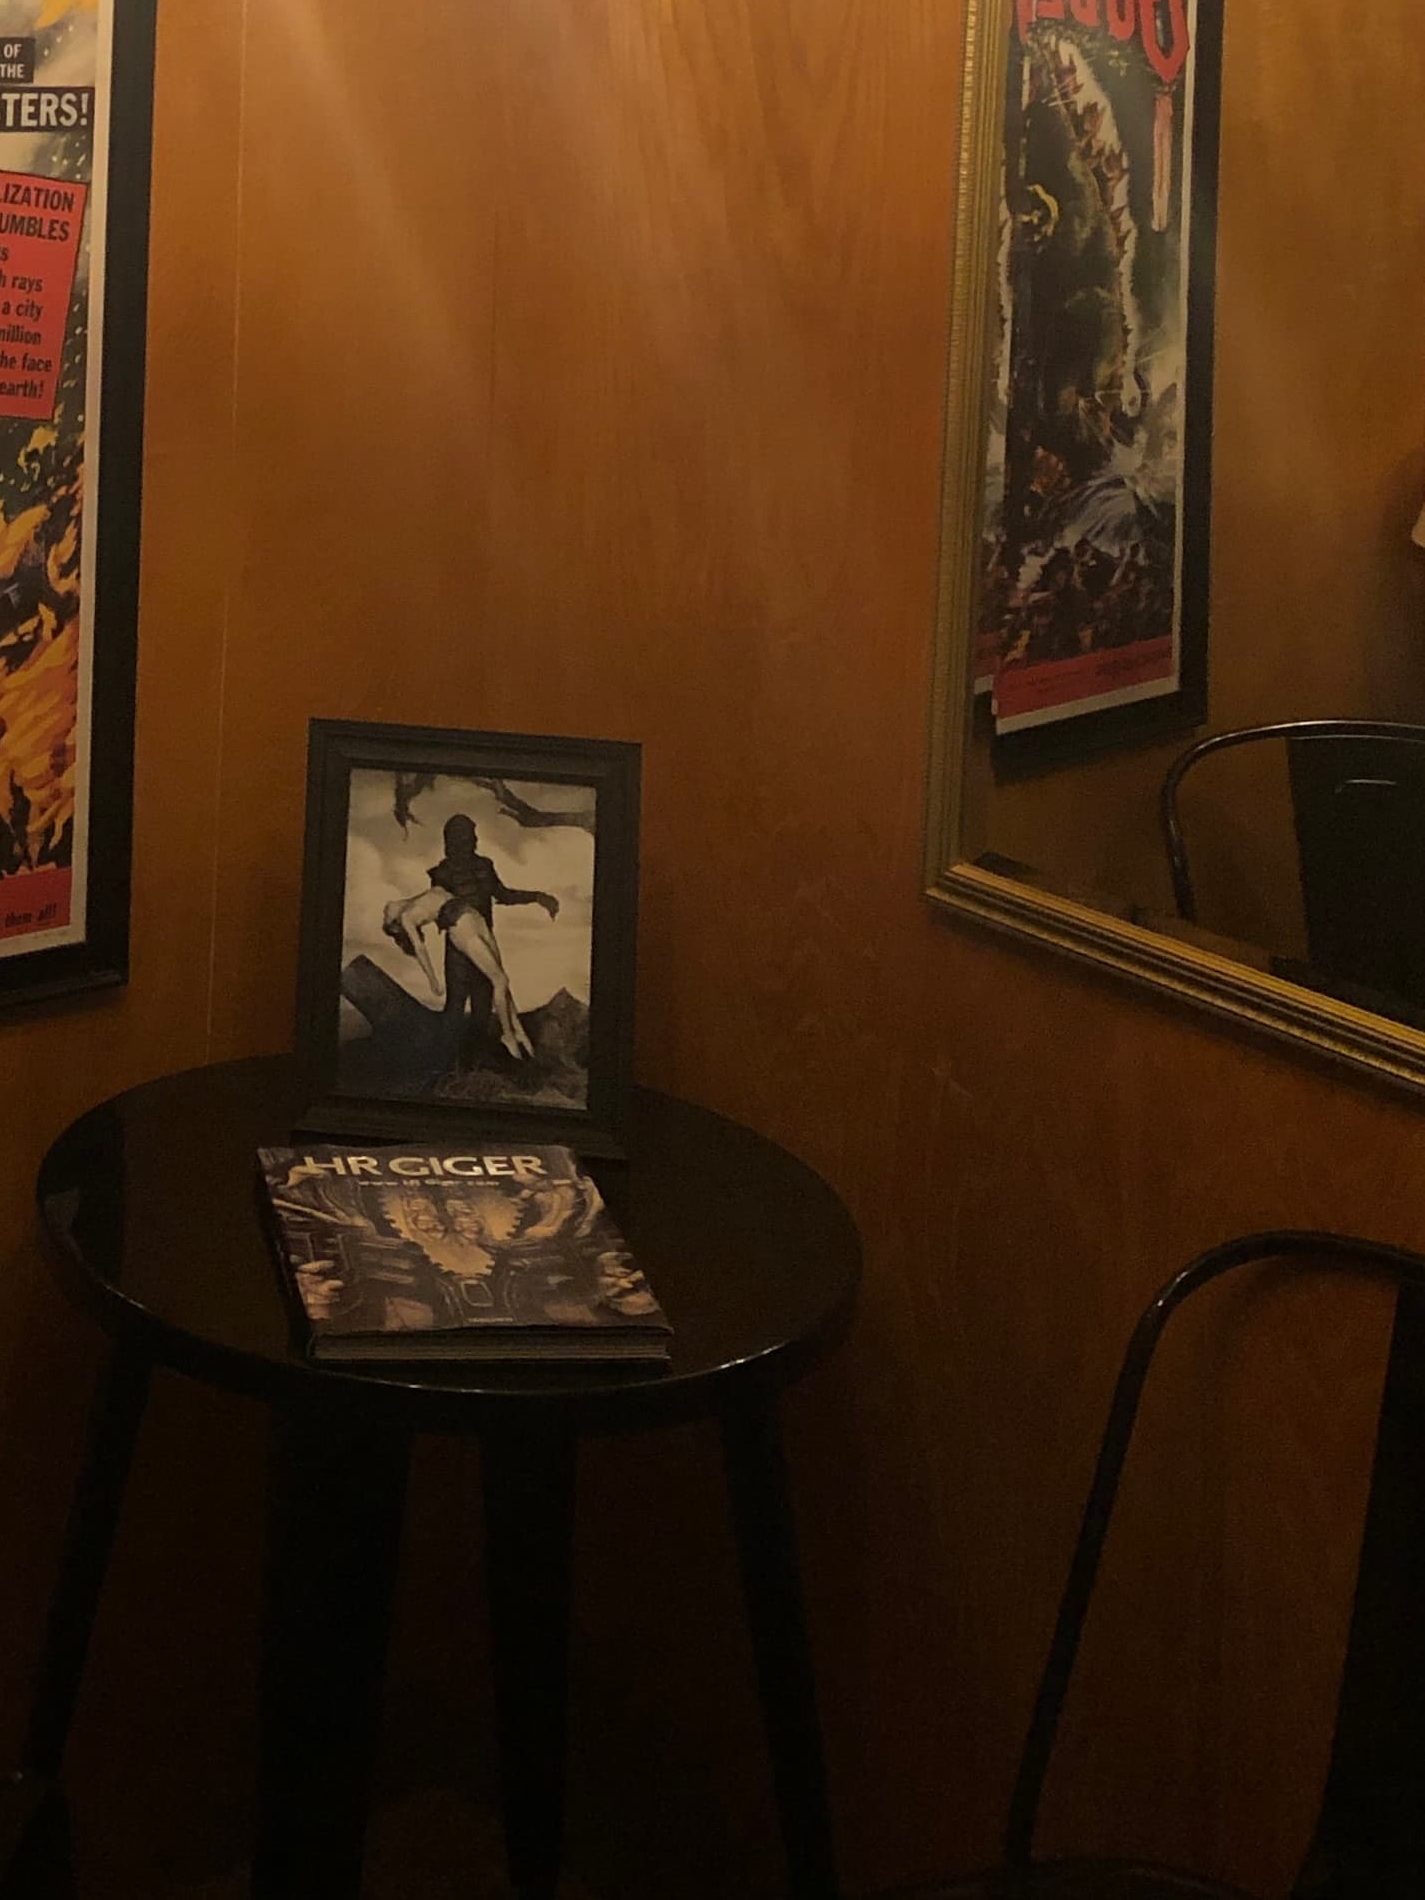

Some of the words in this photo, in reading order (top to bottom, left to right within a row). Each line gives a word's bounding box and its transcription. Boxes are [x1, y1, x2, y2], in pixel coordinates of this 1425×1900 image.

[3, 43, 21, 59] OF
[0, 63, 24, 79] THE
[11, 274, 43, 294] rays
[1, 302, 11, 316] a
[16, 299, 43, 322] city
[21, 351, 52, 373] face
[303, 1155, 381, 1176] HR
[389, 1155, 548, 1177] GIGER
